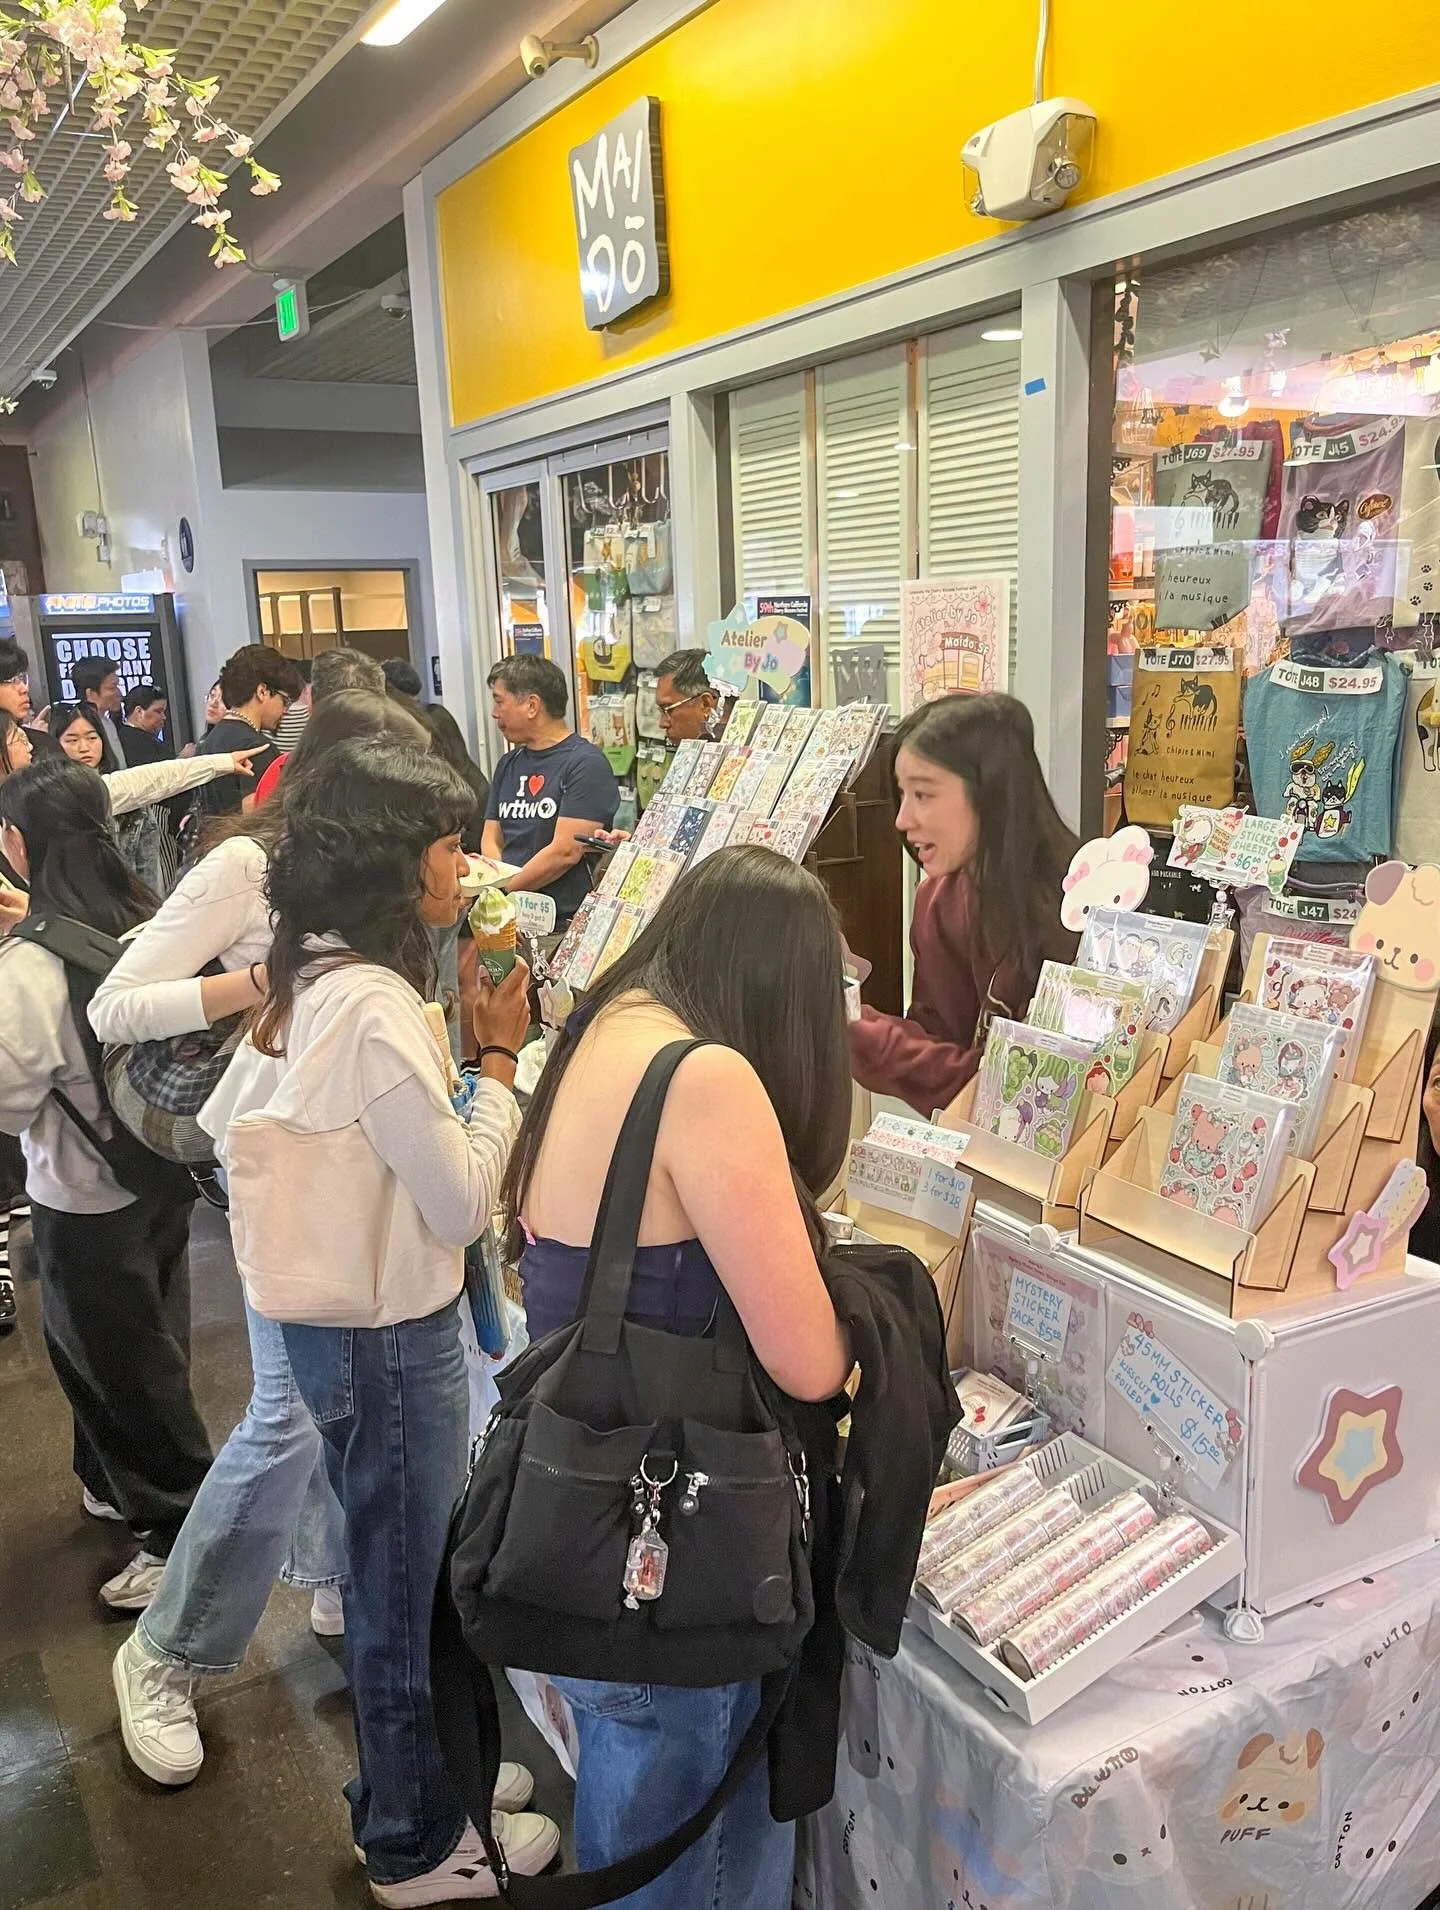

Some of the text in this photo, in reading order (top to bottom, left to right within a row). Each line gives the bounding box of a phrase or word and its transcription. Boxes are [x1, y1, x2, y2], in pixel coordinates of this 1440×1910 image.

[573, 129, 643, 240] MAI
[1185, 447, 1207, 459] J69
[1212, 446, 1255, 459] $27.95
[1167, 571, 1211, 584] heureux
[97, 596, 151, 609] PHOTOS
[1181, 591, 1229, 605] musique
[720, 630, 768, 648] Atelier
[56, 637, 151, 664] CHOOSE
[1145, 655, 1230, 666] TOTE J70 $27.95
[744, 651, 778, 673] By Jo
[1278, 668, 1378, 689] TOTE J48 $24.95
[516, 775, 528, 797] I
[1160, 771, 1195, 785] heureux
[1244, 818, 1277, 834] LARGE
[1232, 841, 1267, 856] SHEETS
[1240, 830, 1279, 848] STICKER
[525, 897, 538, 910] for
[540, 900, 550, 914] $5
[1268, 898, 1295, 915] TOTE
[1301, 905, 1325, 918] J47
[934, 1171, 949, 1184] for
[949, 1175, 967, 1191] $10
[921, 1182, 929, 1193] 3
[930, 1186, 944, 1199] for
[943, 1189, 962, 1210] $28
[1015, 1277, 1064, 1311] MYSTERY
[1009, 1307, 1034, 1327] PACK
[1014, 1292, 1058, 1322] STICKER
[1114, 1373, 1142, 1404] FOILED
[1134, 1333, 1224, 1431] 45MM STICKER
[1150, 1371, 1184, 1409] ROLLS
[1364, 1620, 1411, 1669] PLUTO
[1176, 1678, 1233, 1696] COTTON
[1220, 1827, 1272, 1845] PUFF
[1334, 1811, 1353, 1869] COTTON
